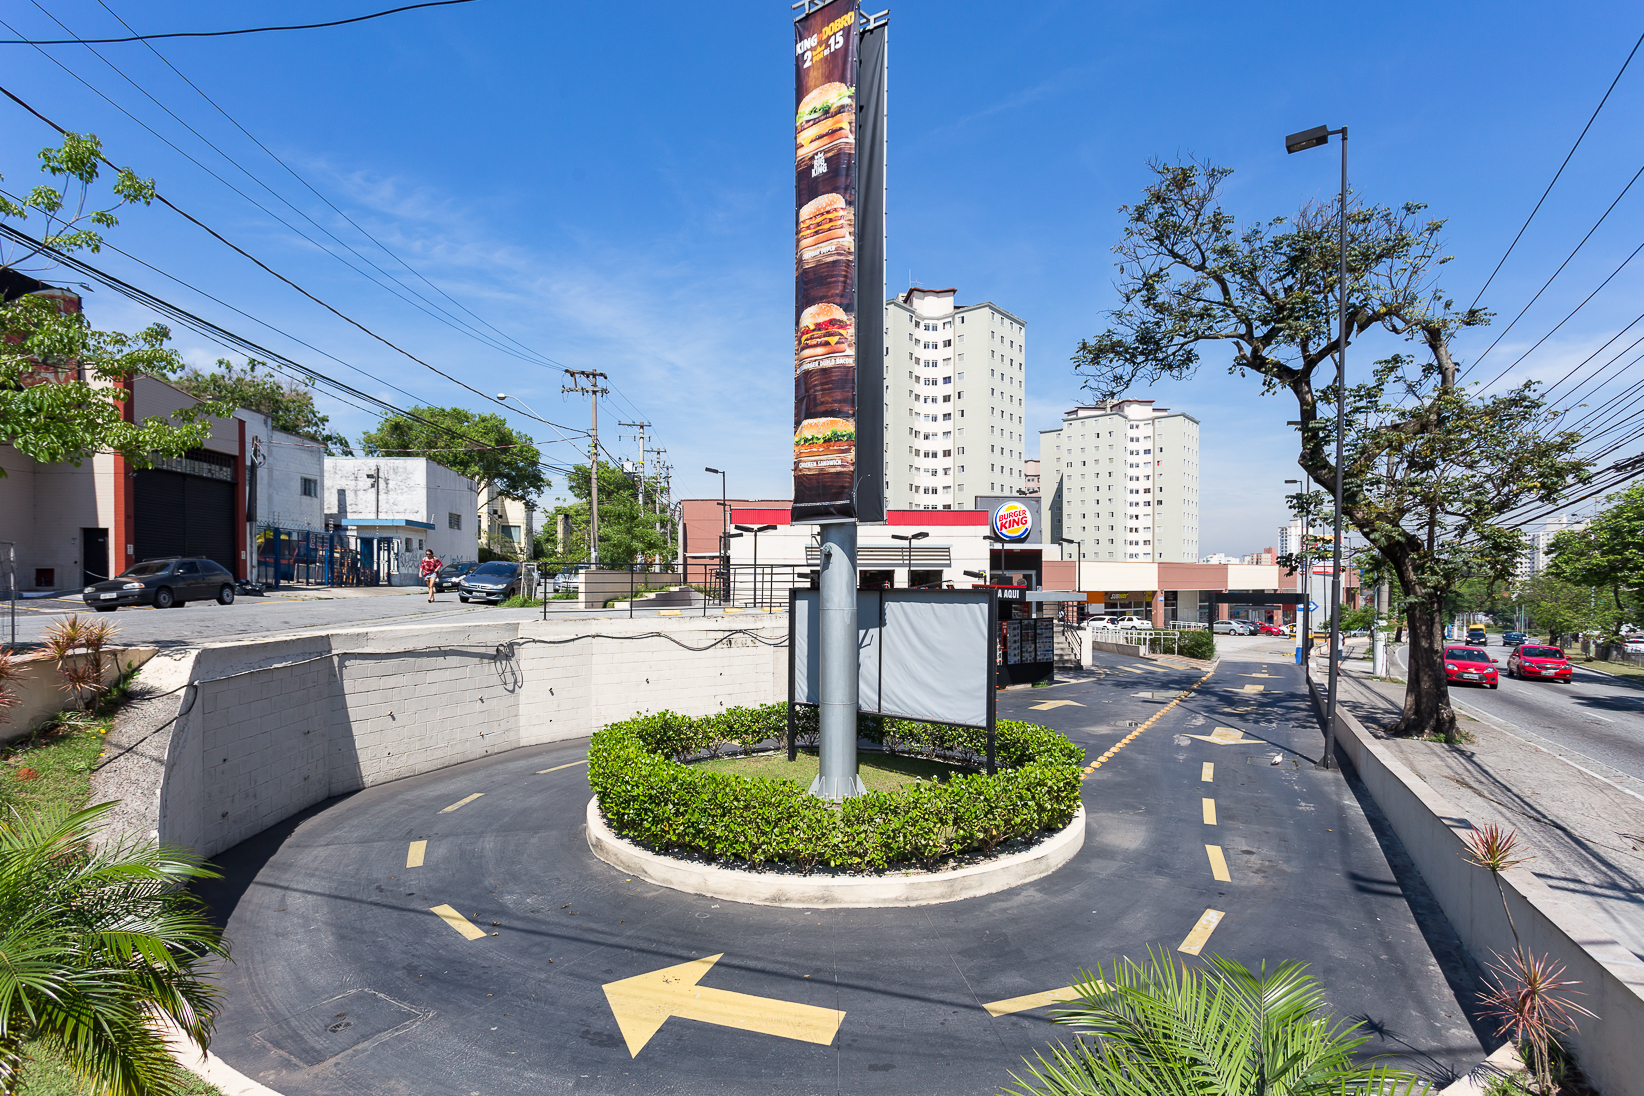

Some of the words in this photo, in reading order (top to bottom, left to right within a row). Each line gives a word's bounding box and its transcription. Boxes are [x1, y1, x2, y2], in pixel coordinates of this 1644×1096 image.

[796, 33, 817, 56] KING
[822, 11, 855, 40] DOBRO
[803, 50, 813, 68] 2
[812, 163, 828, 178] KING
[999, 509, 1027, 522] BURGER
[1000, 516, 1028, 531] KING
[1003, 589, 1020, 599] AQUI
